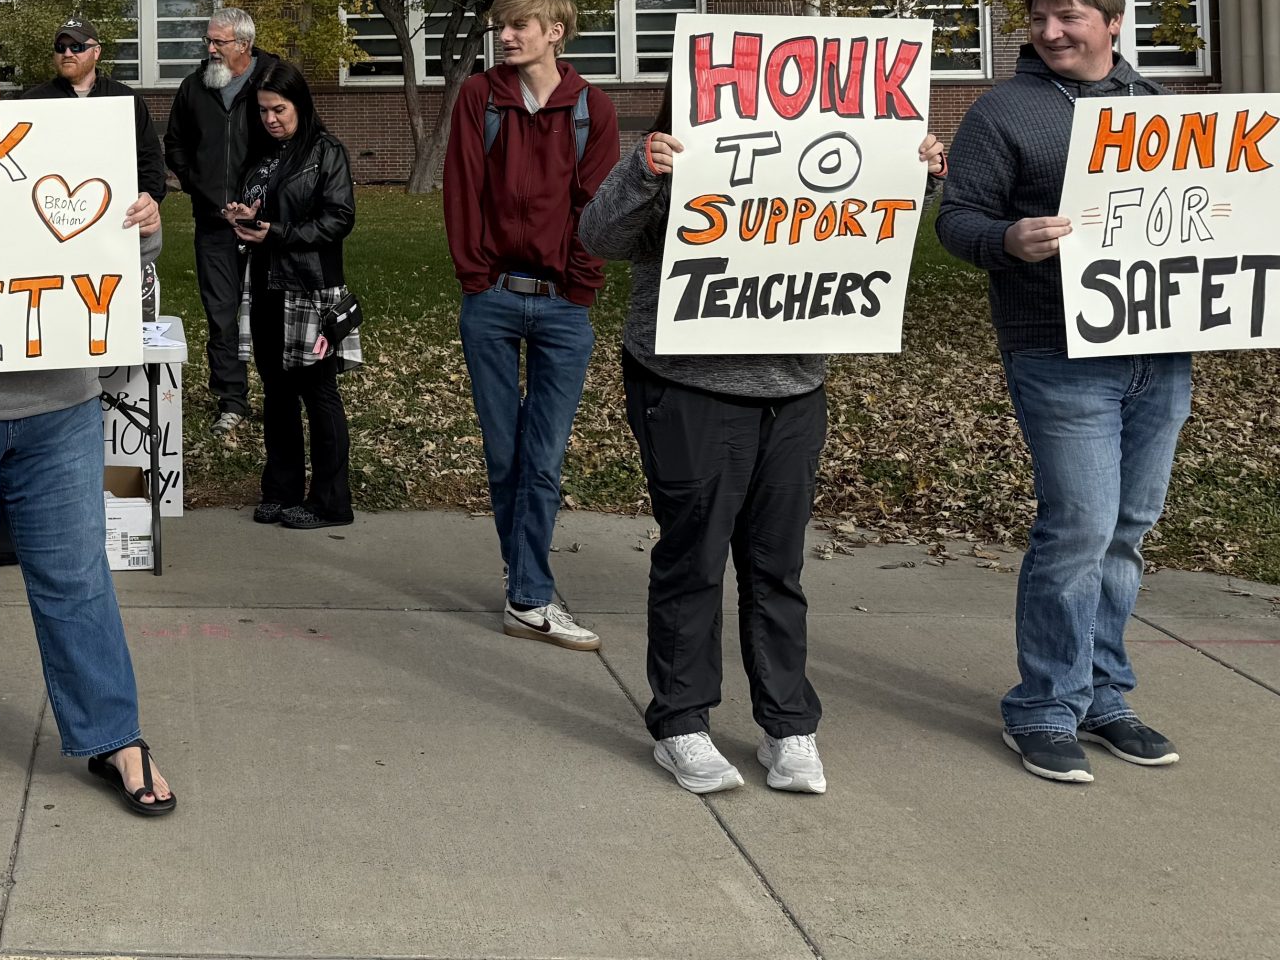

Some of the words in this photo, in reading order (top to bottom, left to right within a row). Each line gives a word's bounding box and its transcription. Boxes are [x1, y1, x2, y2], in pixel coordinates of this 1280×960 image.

[689, 30, 924, 127] HONK
[715, 130, 863, 194] TO
[1088, 107, 1280, 174] HONK
[44, 195, 87, 212] BRONC
[48, 210, 86, 226] Nation
[677, 194, 917, 246] SUPPORT
[1102, 185, 1215, 249] FOR
[666, 257, 892, 323] TEACHERS
[1076, 254, 1280, 344] SAFET
[103, 419, 179, 457] HOOL
